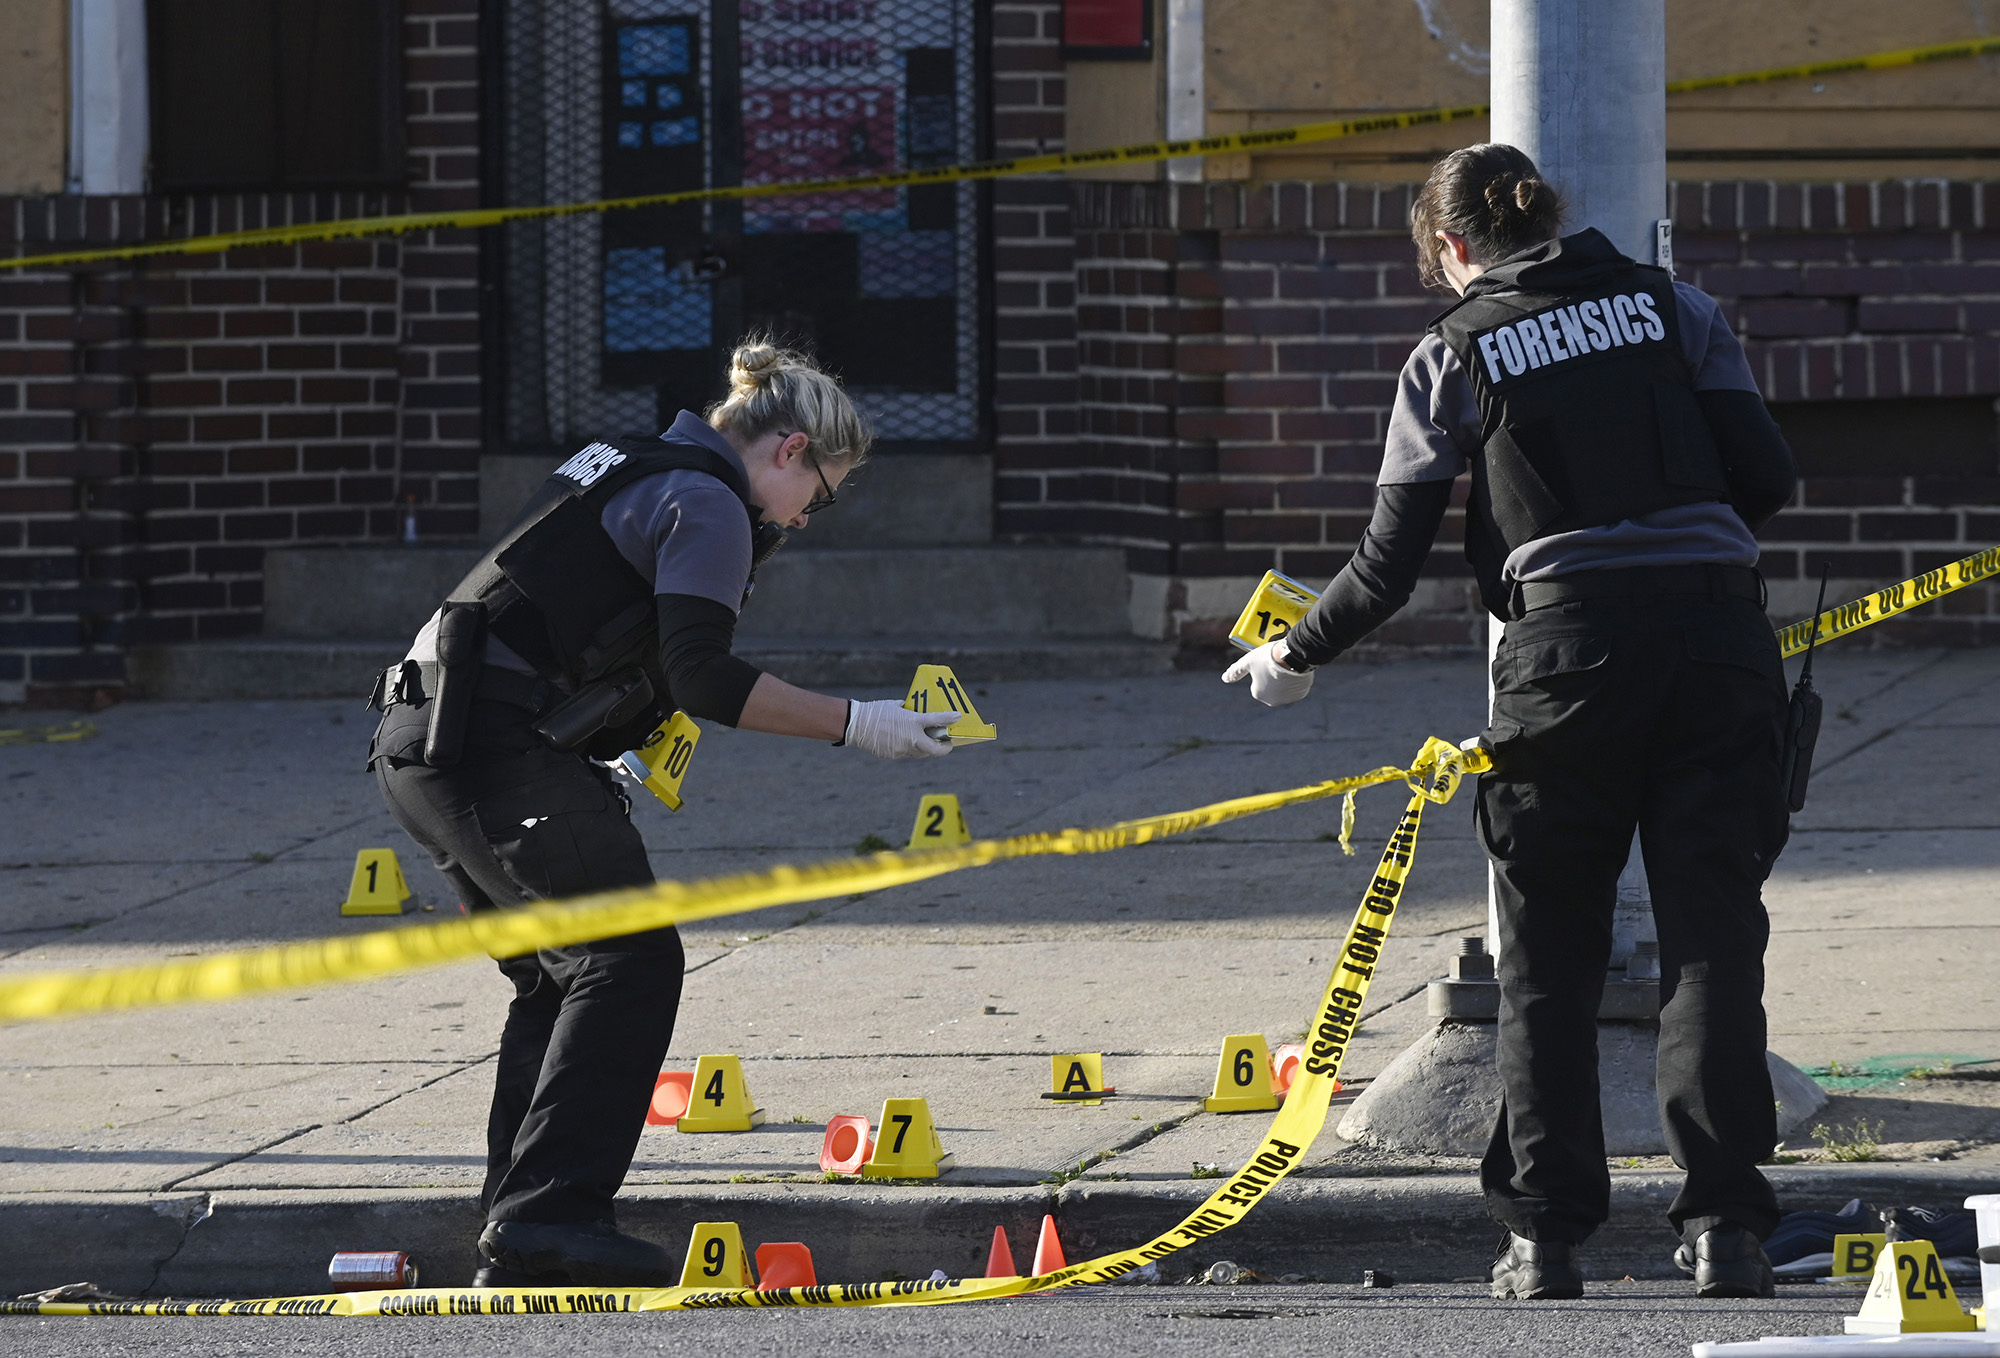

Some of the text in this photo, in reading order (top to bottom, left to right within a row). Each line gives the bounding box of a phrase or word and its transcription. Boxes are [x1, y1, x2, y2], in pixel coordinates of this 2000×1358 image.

[789, 91, 882, 119] NOT
[1477, 292, 1665, 384] FORENSICS
[1257, 610, 1291, 642] 12
[911, 689, 927, 714] 11
[936, 676, 970, 714] 11
[664, 733, 693, 779] 10
[925, 804, 945, 837] 2
[366, 860, 378, 893] 1
[1305, 810, 1419, 1079] LINE DO NOT CROSS
[1062, 1061, 1092, 1092] A
[1233, 1048, 1254, 1087] 6
[704, 1069, 725, 1107] 4
[892, 1114, 912, 1153] 7
[1217, 1138, 1301, 1207] POLICE
[1173, 1208, 1235, 1240] LINE
[703, 1237, 726, 1277] 9
[1846, 1241, 1874, 1273] B
[1874, 1270, 1893, 1299] 24
[1899, 1253, 1947, 1300] 24
